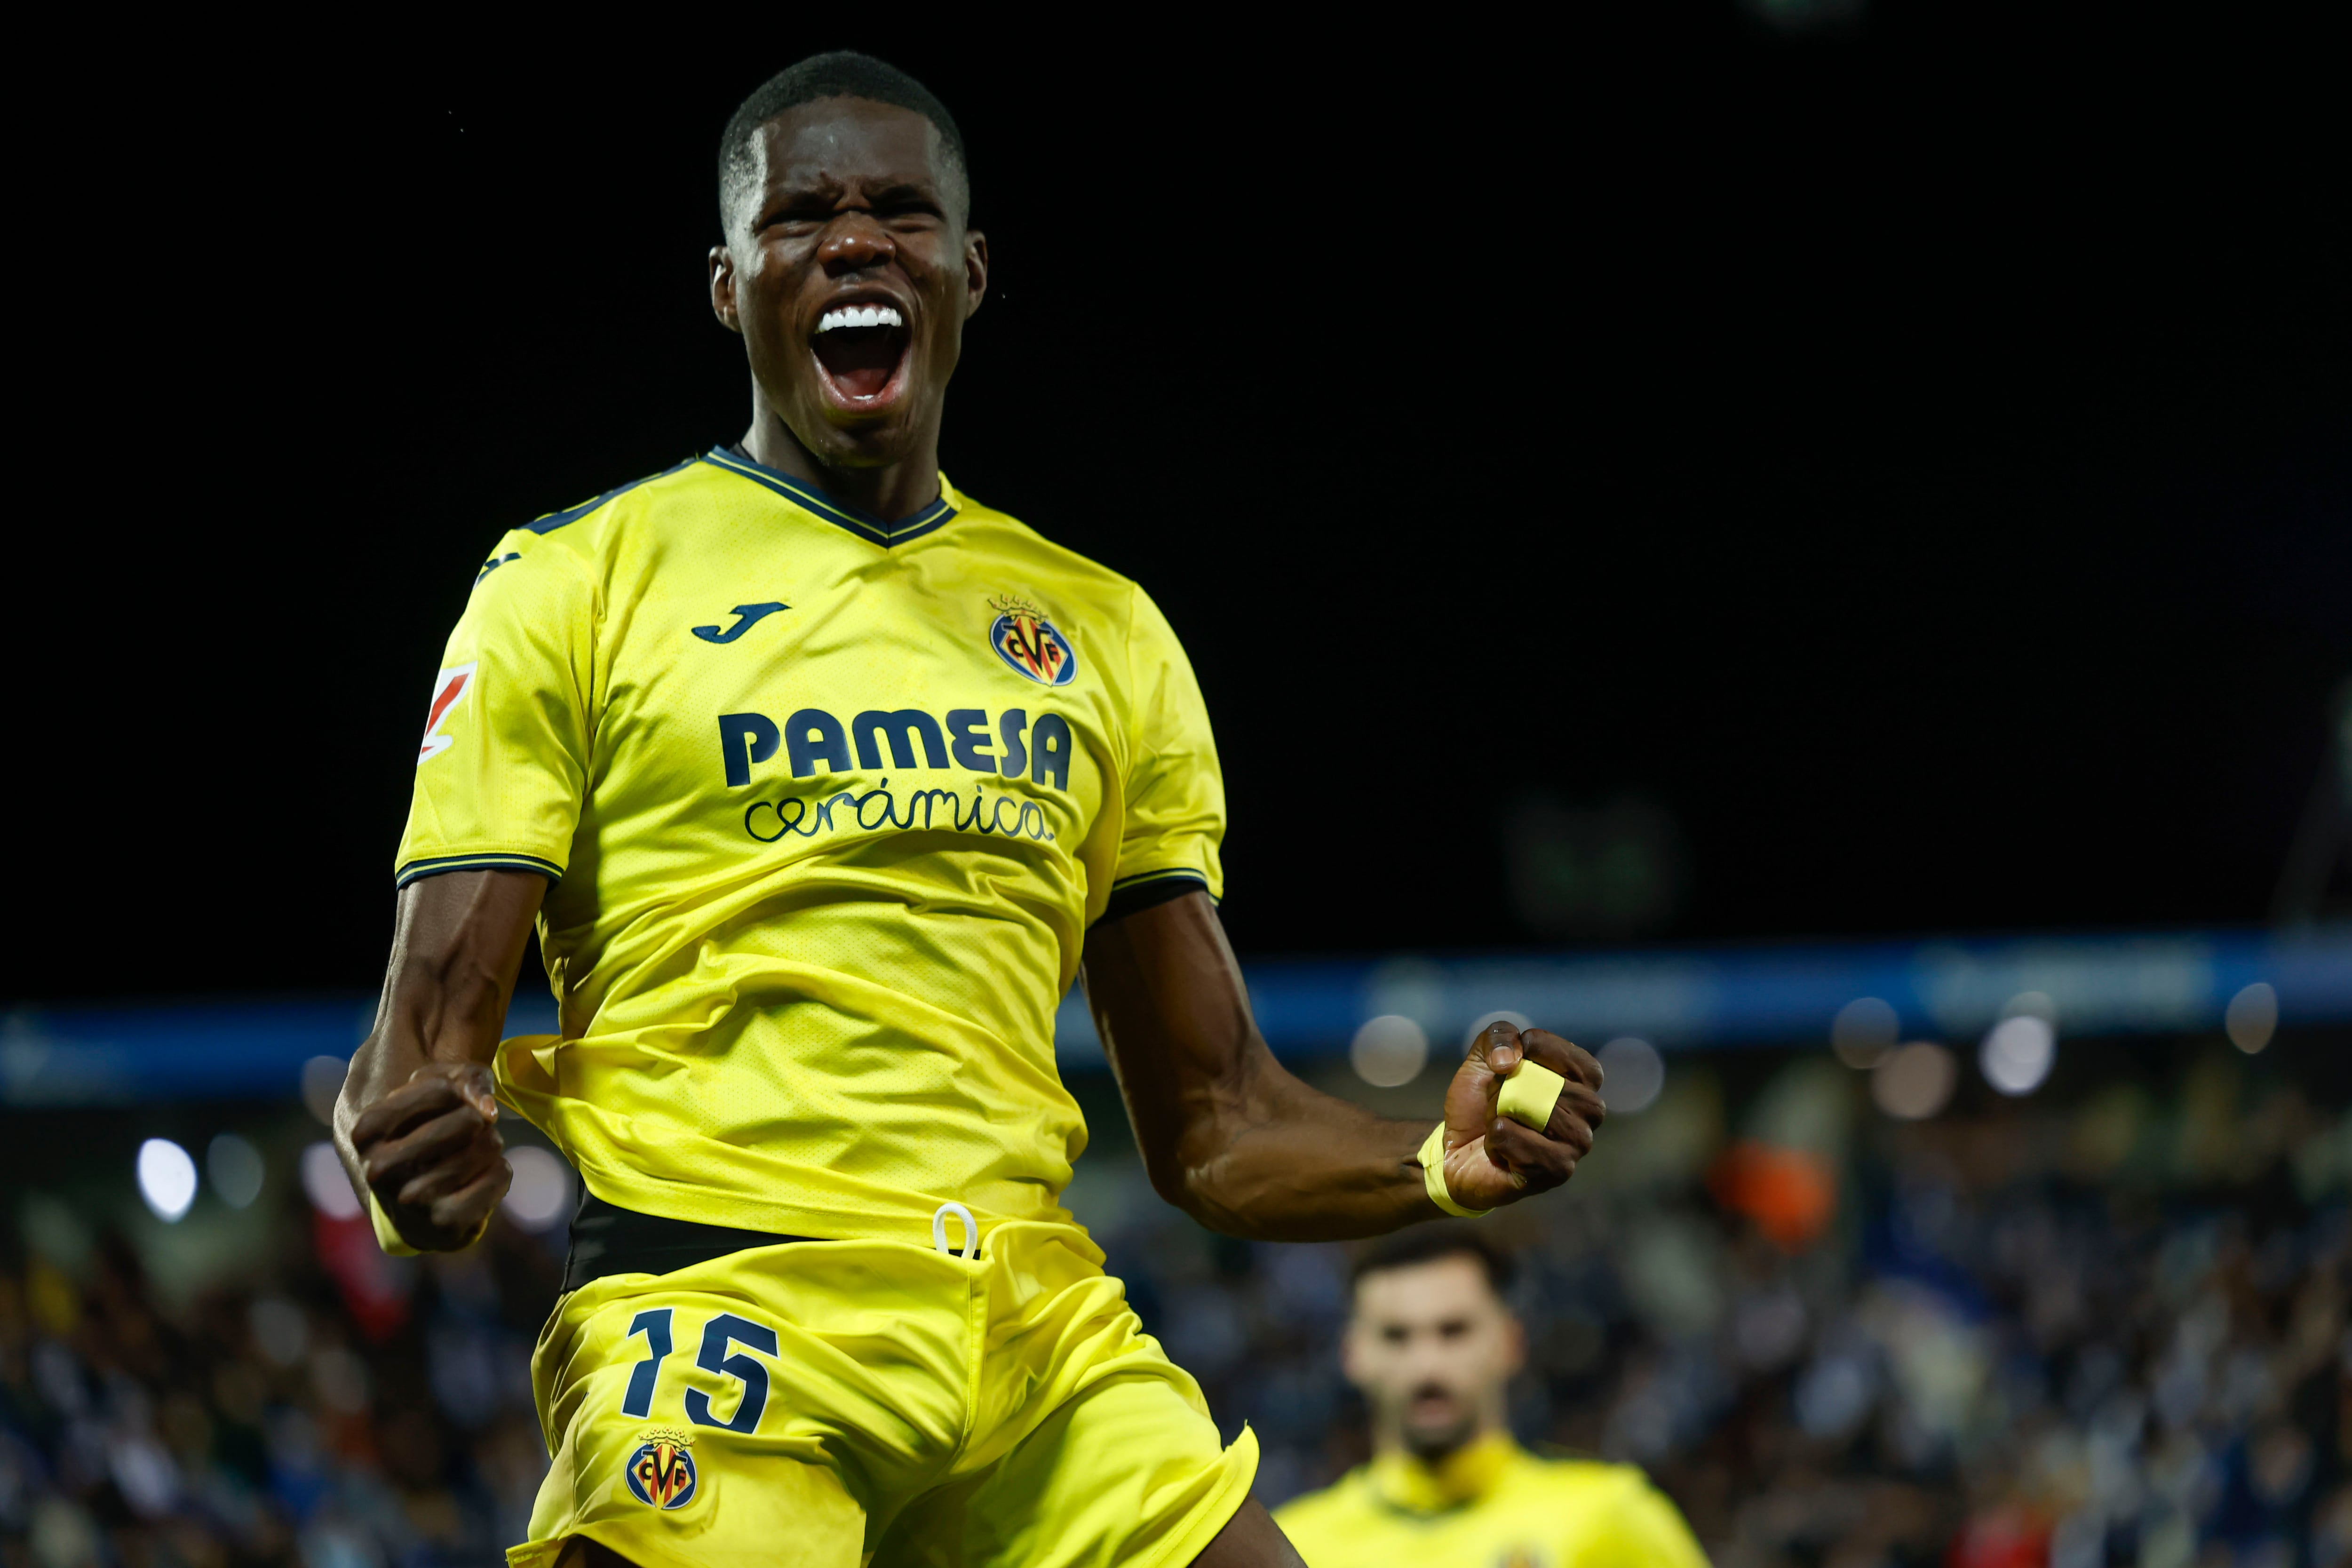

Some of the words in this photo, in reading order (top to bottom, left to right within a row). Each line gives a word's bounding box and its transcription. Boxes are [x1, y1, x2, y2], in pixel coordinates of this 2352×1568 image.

[718, 708, 1072, 791] PAMESA
[745, 777, 1054, 843] cerámica
[620, 1307, 780, 1435] 15
